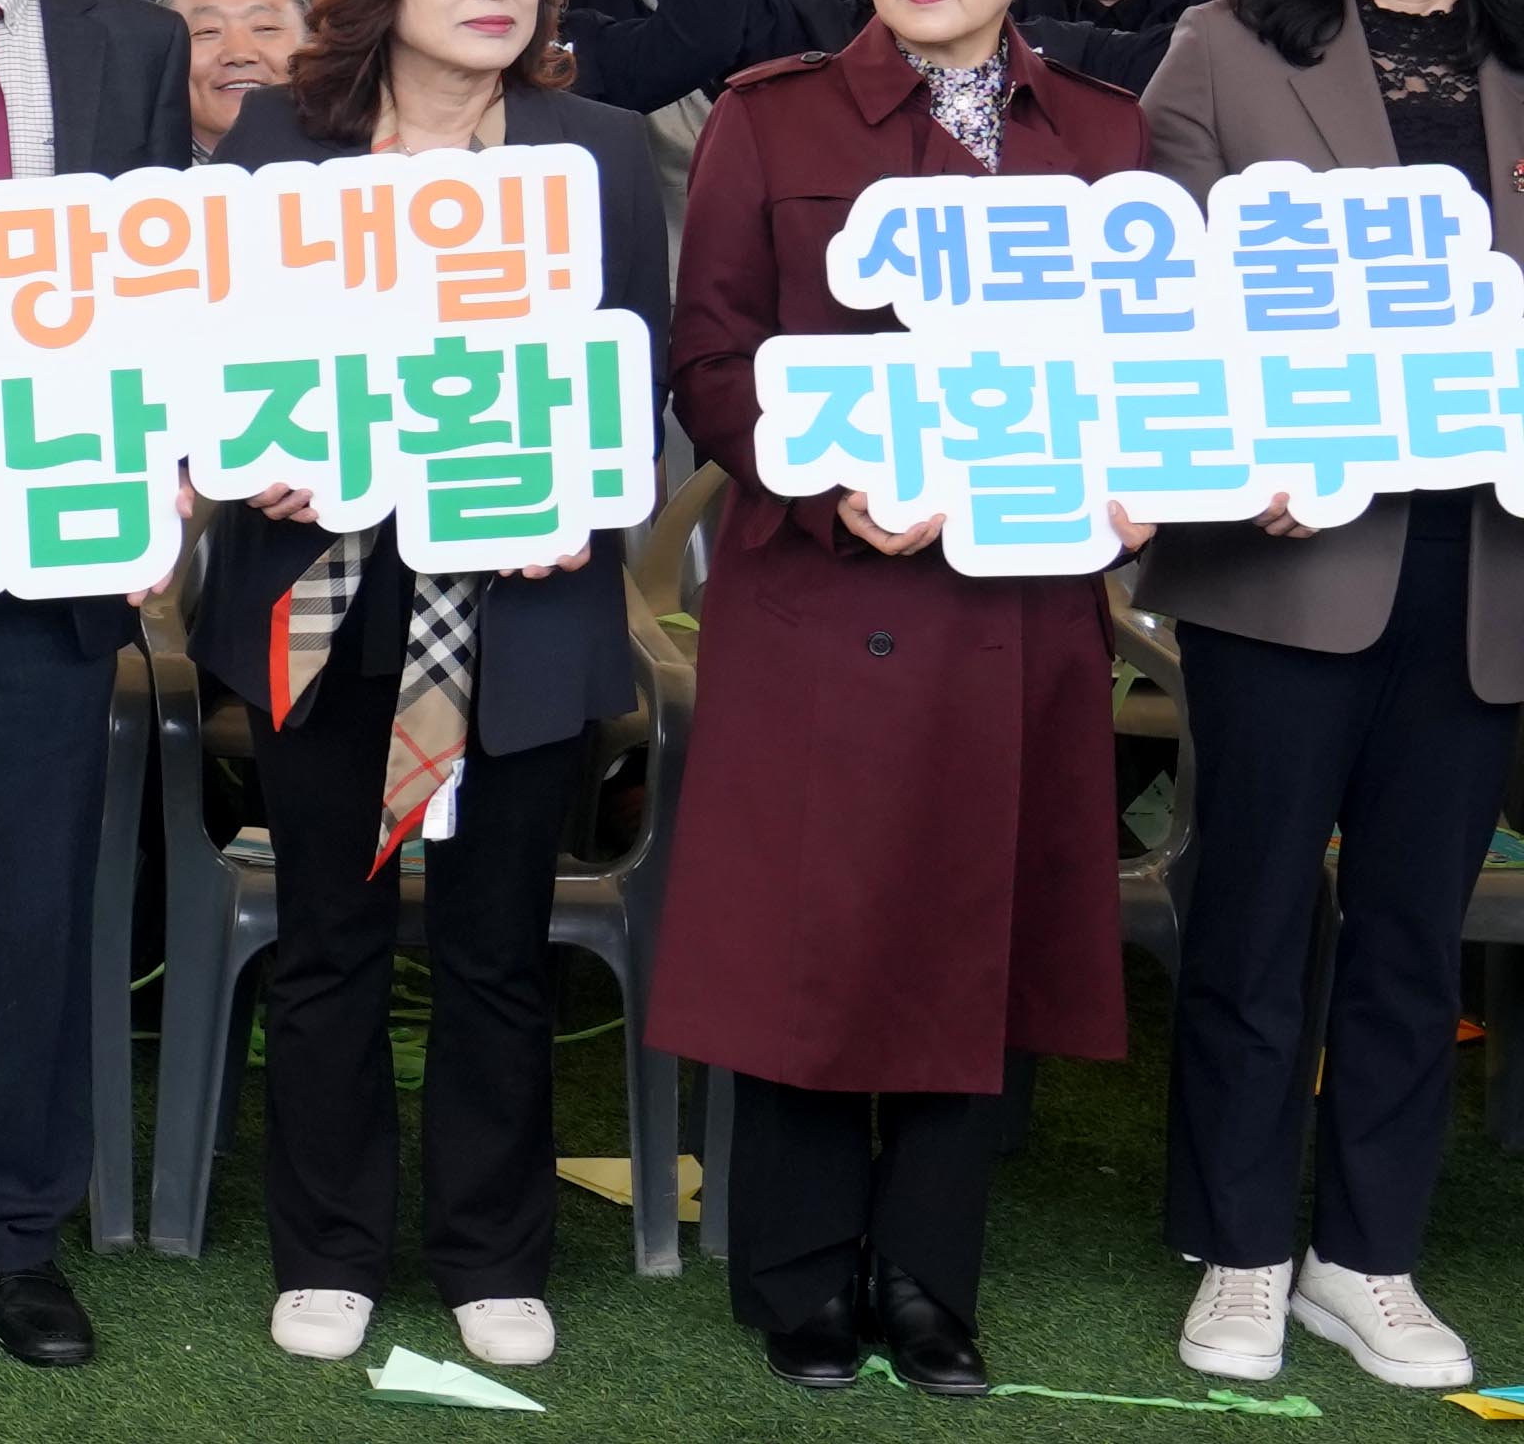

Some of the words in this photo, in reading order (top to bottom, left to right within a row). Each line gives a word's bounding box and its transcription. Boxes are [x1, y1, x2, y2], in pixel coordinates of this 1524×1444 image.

[279, 174, 571, 323] 내일!
[858, 201, 1196, 334] 새로운
[1233, 191, 1494, 332] 출발,
[220, 335, 625, 544] 자활!
[785, 349, 1524, 546] 자활로부터
